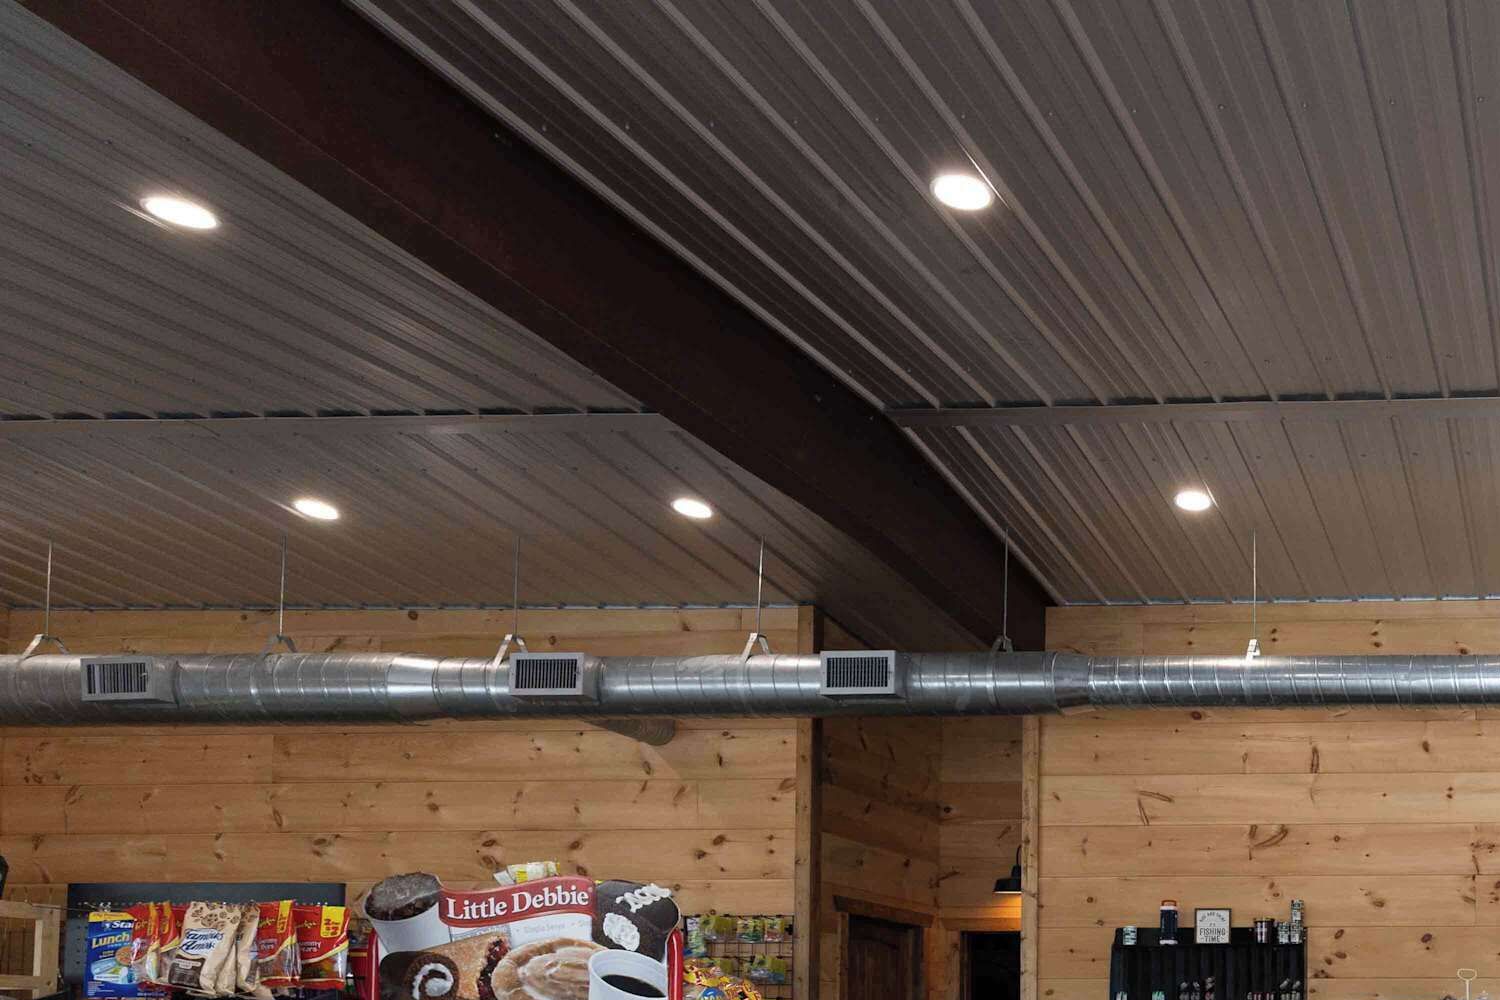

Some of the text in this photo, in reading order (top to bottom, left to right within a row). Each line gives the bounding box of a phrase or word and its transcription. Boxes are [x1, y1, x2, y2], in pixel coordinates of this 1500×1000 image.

[447, 888, 590, 921] Little Debbie
[91, 931, 130, 949] Lunch
[1199, 927, 1226, 936] FISHING
